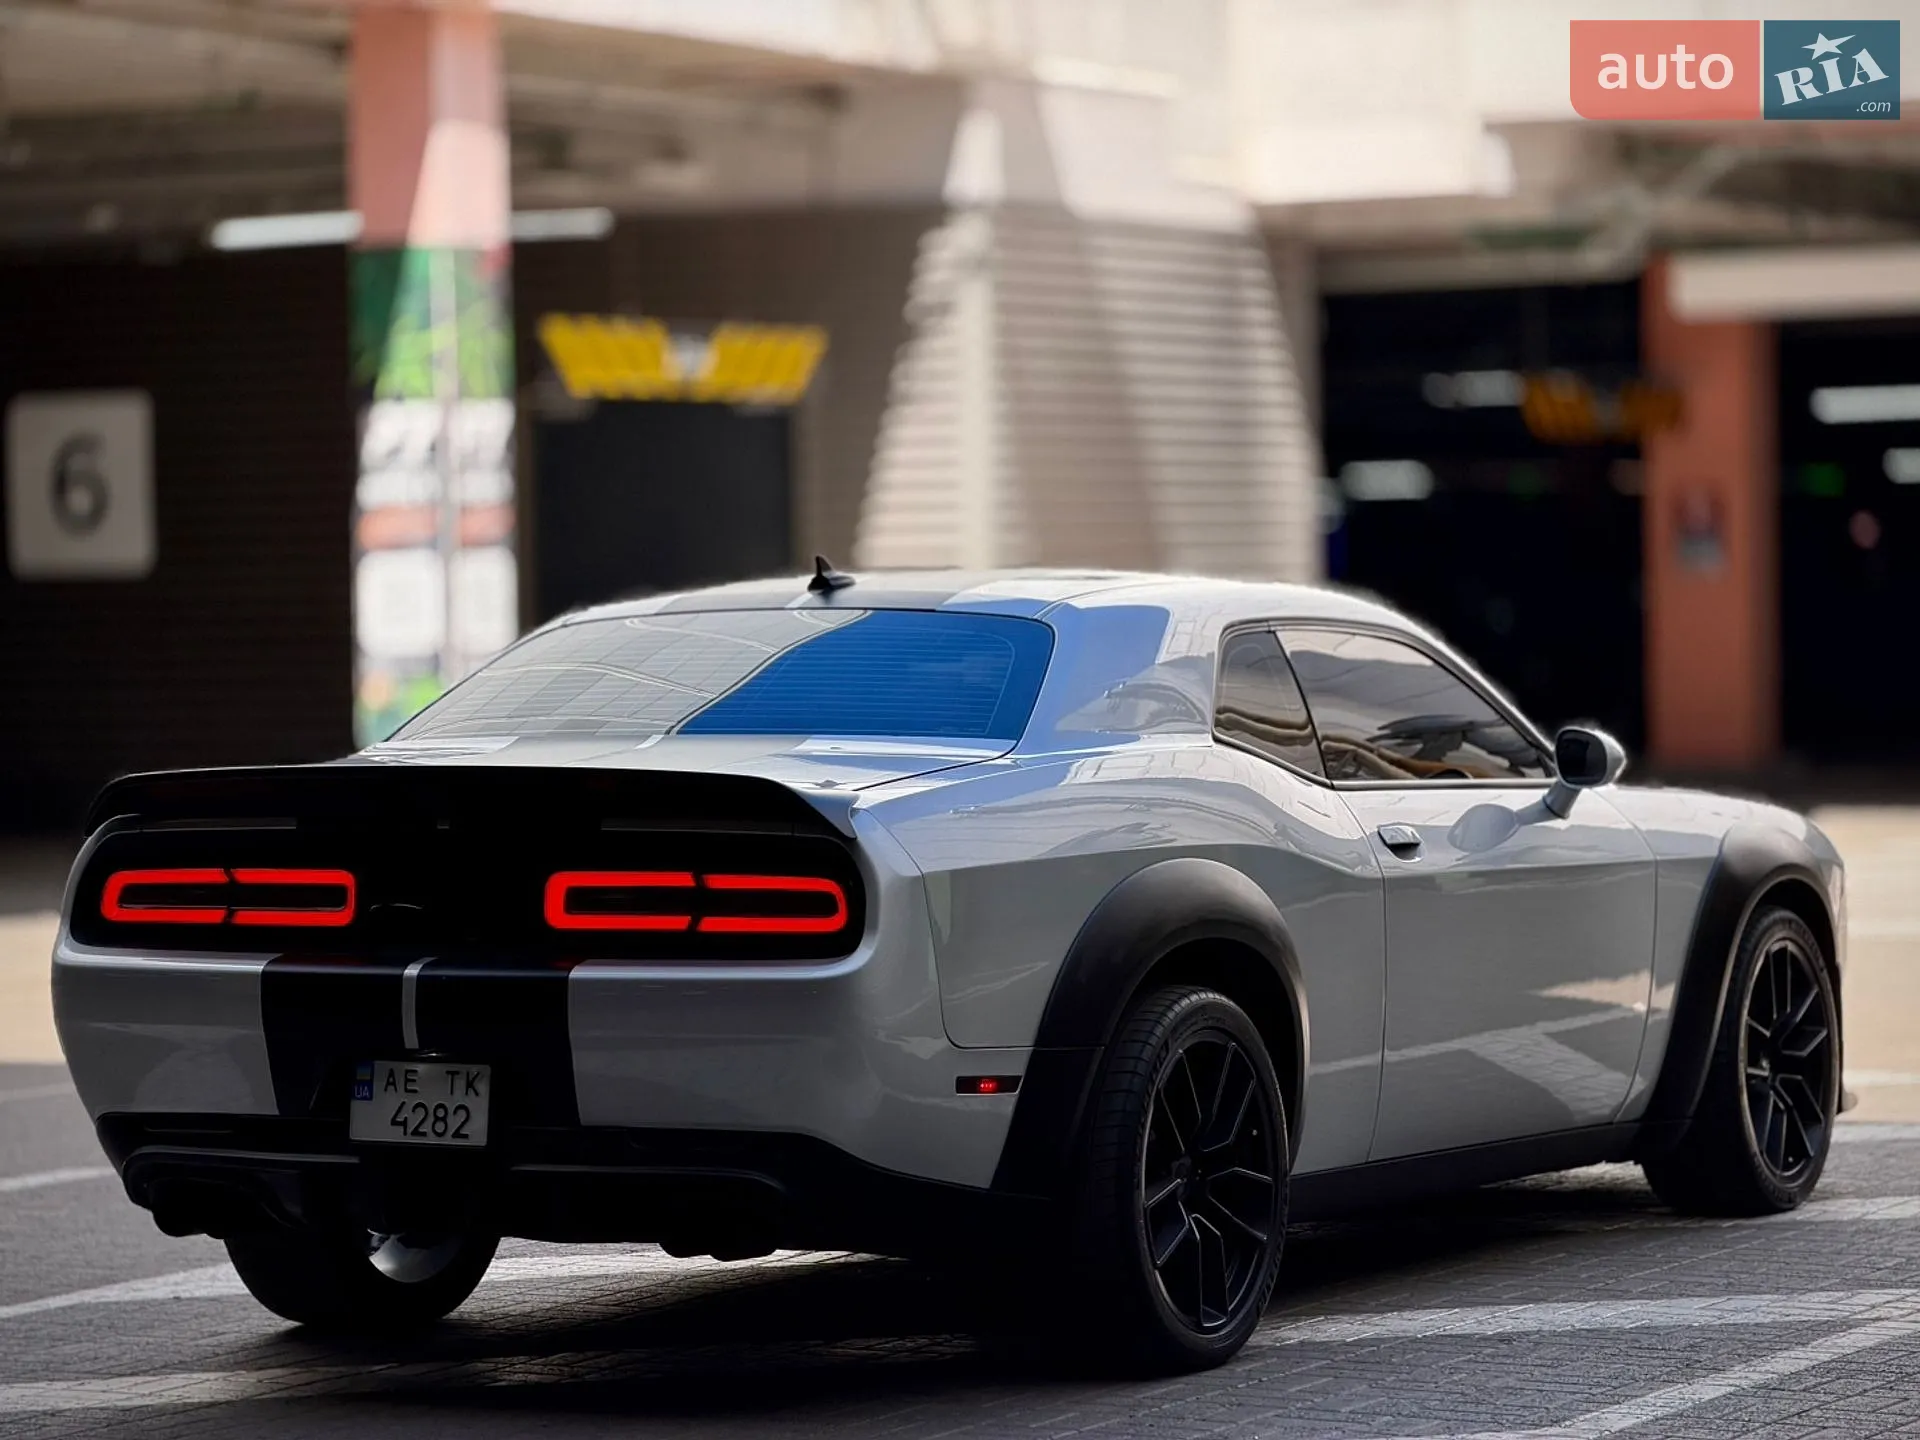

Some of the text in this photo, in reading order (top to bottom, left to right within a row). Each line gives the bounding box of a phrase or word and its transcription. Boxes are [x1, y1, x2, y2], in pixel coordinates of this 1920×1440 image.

[51, 431, 109, 539] 6
[354, 1085, 370, 1099] UA
[383, 1067, 481, 1097] AE TK
[390, 1100, 471, 1139] 4282
